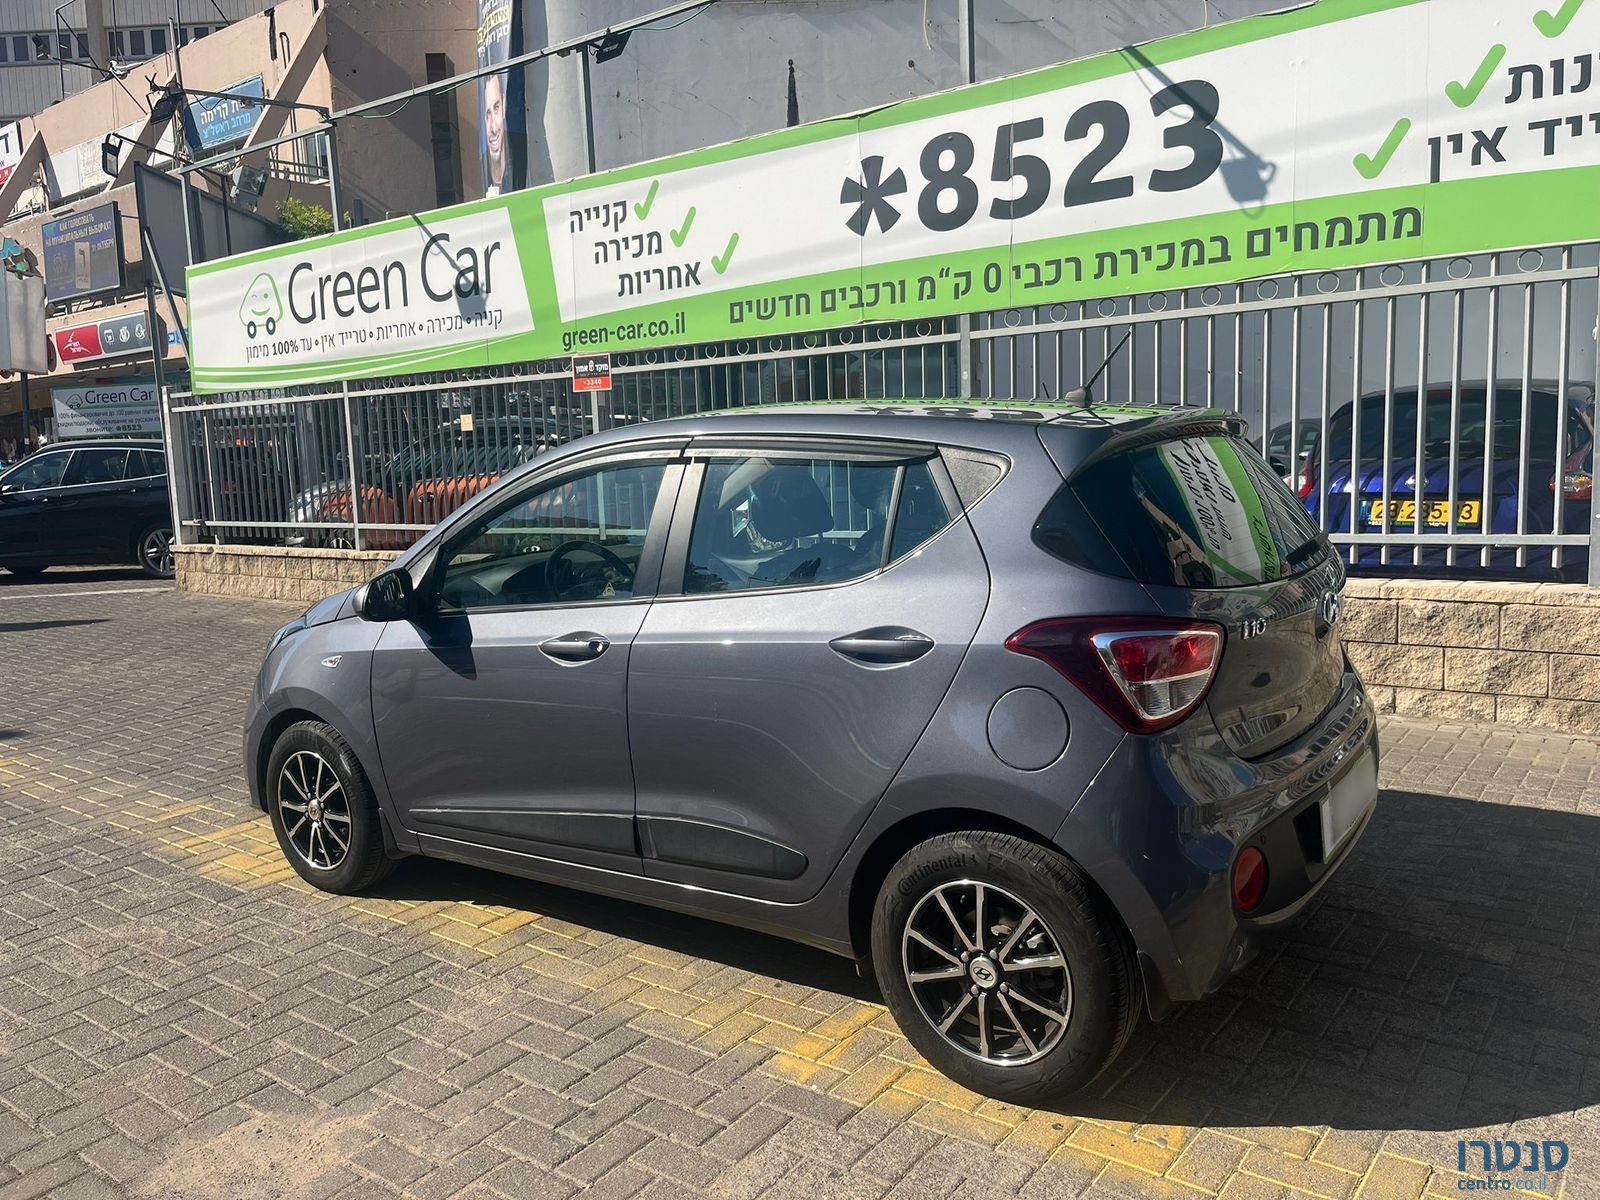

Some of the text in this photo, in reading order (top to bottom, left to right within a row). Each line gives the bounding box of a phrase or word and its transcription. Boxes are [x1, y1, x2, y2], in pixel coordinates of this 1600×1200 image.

[1504, 52, 1600, 104] נות
[1428, 126, 1508, 184] אין
[570, 200, 628, 234] קנייה
[1246, 206, 1422, 259] מתמחים
[594, 231, 663, 264] מכירה
[1094, 234, 1232, 281] במכירת
[287, 233, 500, 324] Green Car
[618, 261, 702, 297] אחריות
[983, 262, 1002, 294] 0
[1012, 253, 1082, 289] רכבי
[729, 292, 811, 324] חדשים
[820, 279, 906, 313] ורכבים
[246, 308, 503, 363] קניה מכירה אחריות טרייד אין עד 100% מימון
[562, 311, 686, 351] green-car.co.il
[85, 388, 154, 404] Green Car
[897, 853, 967, 896] Continental
